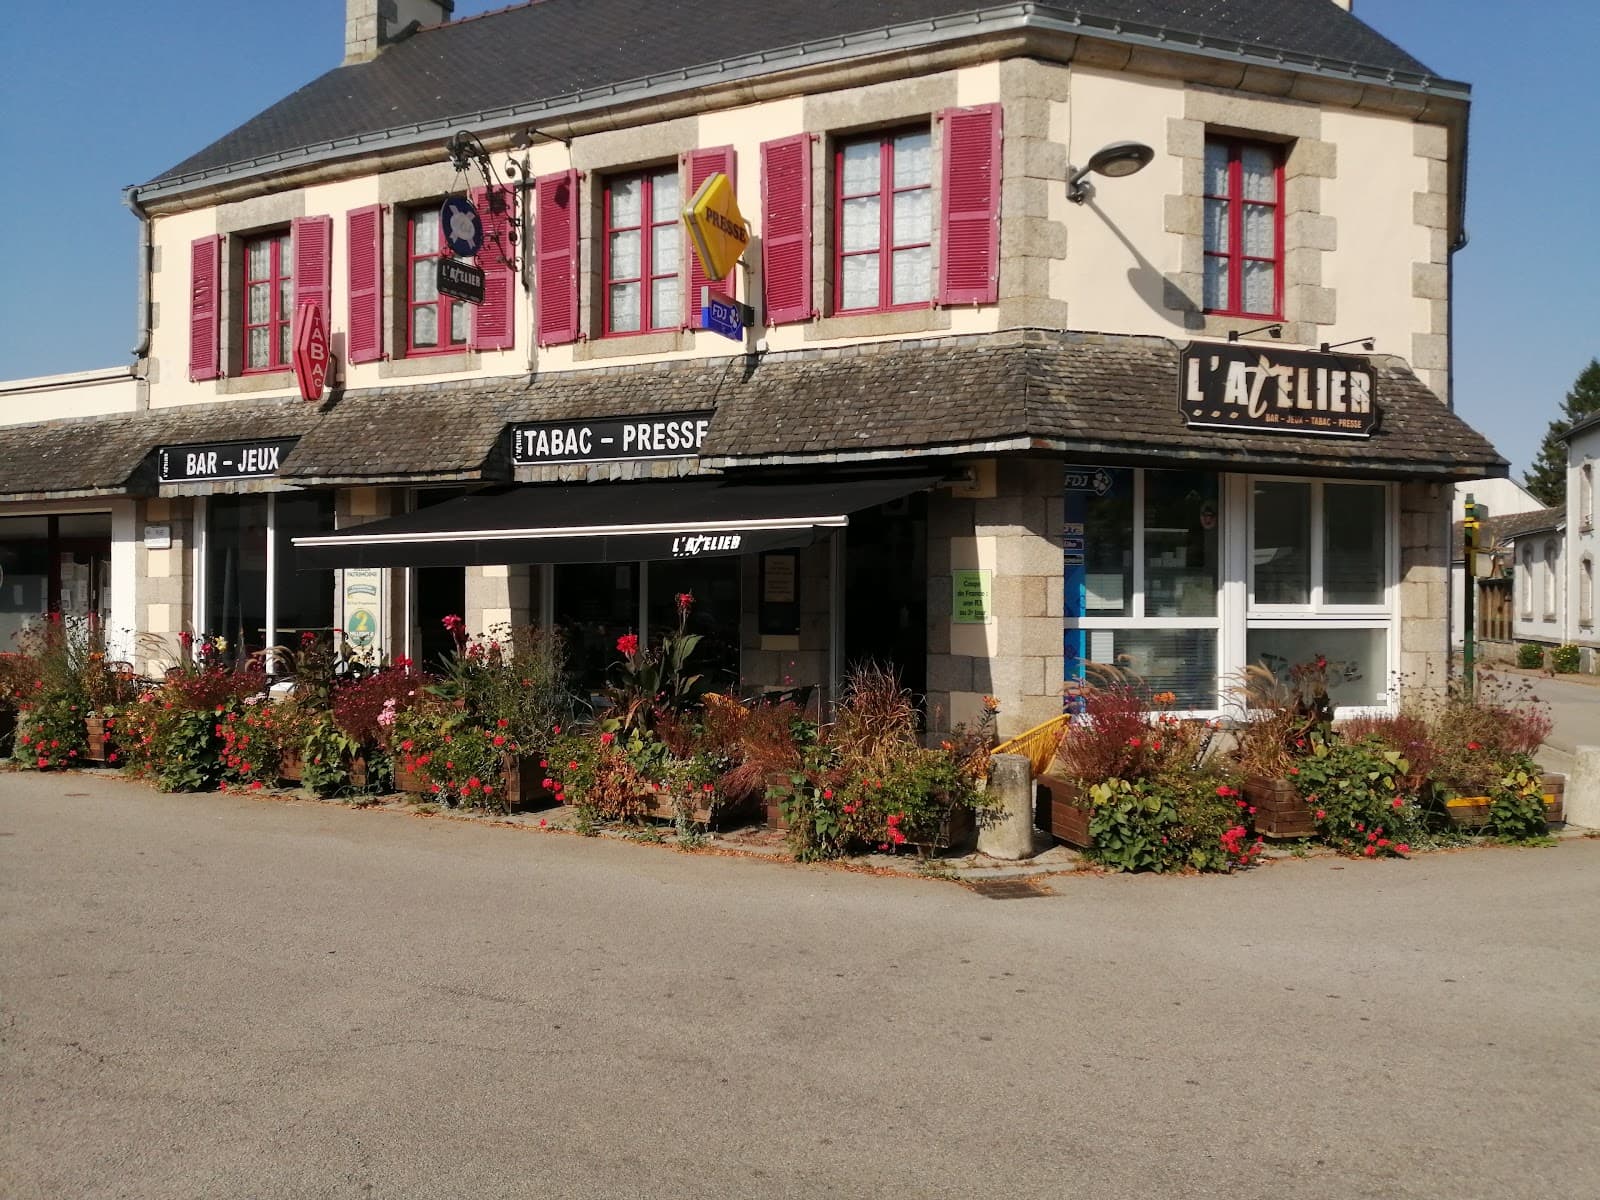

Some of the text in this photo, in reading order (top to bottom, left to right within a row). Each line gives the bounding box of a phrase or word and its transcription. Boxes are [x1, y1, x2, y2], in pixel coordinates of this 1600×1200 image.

[706, 206, 748, 244] PRESSE
[712, 303, 728, 320] FDJ
[310, 317, 325, 388] TABAC
[1186, 354, 1371, 419] L'ATELIER
[1265, 413, 1279, 423] BAR
[1311, 416, 1331, 427] TABAC
[1338, 418, 1363, 429] PRESSE
[524, 427, 593, 457] TABAC
[186, 452, 218, 476] BAR
[237, 447, 280, 473] JEUX
[1064, 475, 1089, 487] FDJ
[672, 534, 741, 555] L'ATELIER
[355, 610, 368, 632] 2
